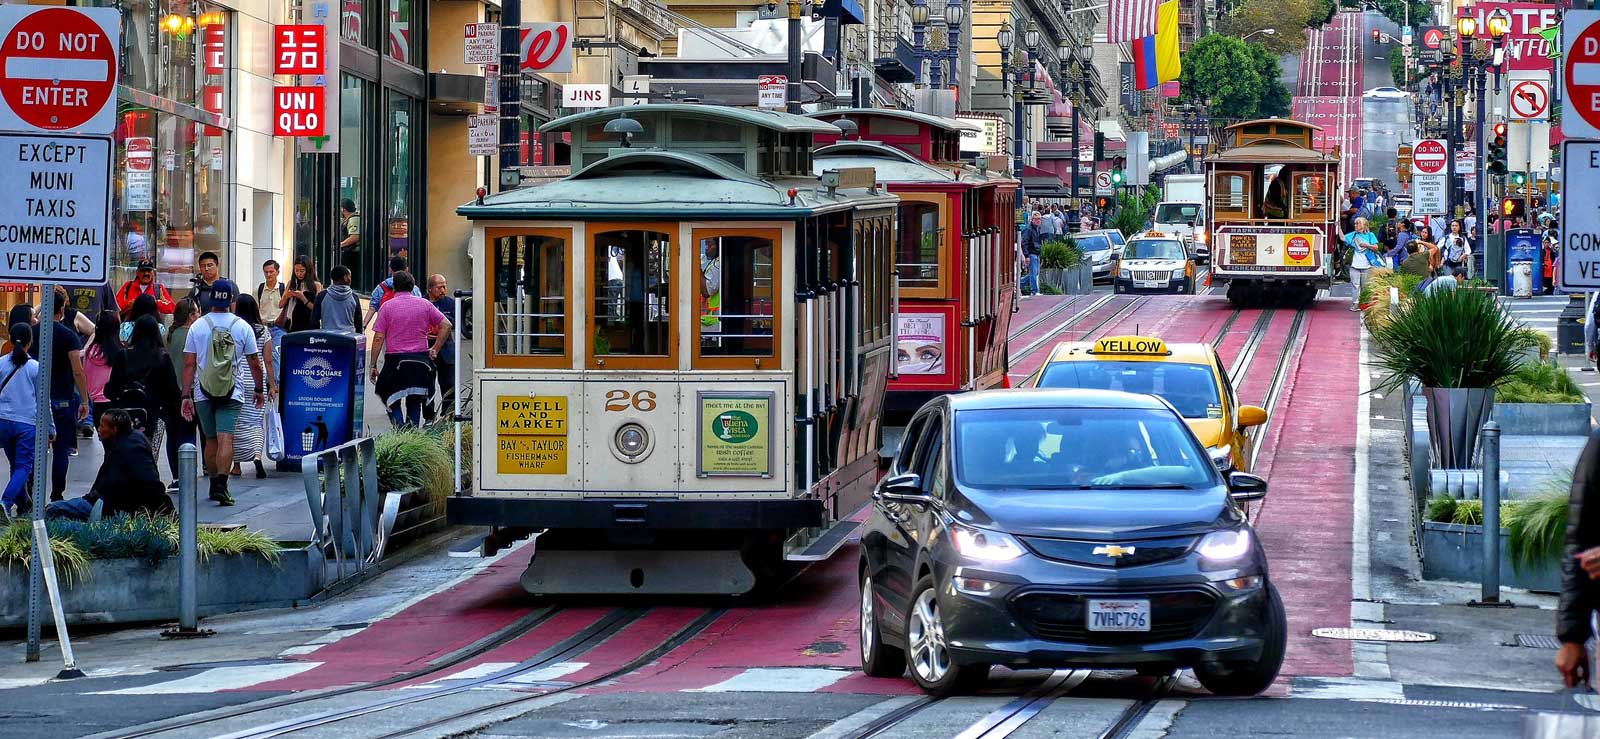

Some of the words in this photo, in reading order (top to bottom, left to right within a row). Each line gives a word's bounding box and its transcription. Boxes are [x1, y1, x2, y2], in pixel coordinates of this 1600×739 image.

[466, 25, 475, 37] NO
[1475, 9, 1555, 35] HOTE
[17, 31, 45, 50] DO
[59, 33, 99, 52] NOT
[1121, 75, 1130, 95] DSW
[22, 86, 89, 107] ENTER
[478, 118, 496, 127] PARKING
[19, 144, 87, 164] EXCEPT
[30, 172, 73, 191] MUNI
[26, 198, 76, 218] TAXIS
[0, 225, 101, 246] COMMERCIAL
[1264, 246, 1275, 254] 4
[6, 253, 92, 273] VEHICLES
[1100, 340, 1161, 353] YELLOW
[502, 402, 563, 410] POWELL
[604, 389, 657, 412] 26
[500, 420, 564, 428] MARKET
[501, 440, 517, 450] BAY
[532, 440, 564, 451] TAYLOR
[1092, 612, 1146, 626] 7VHC796
